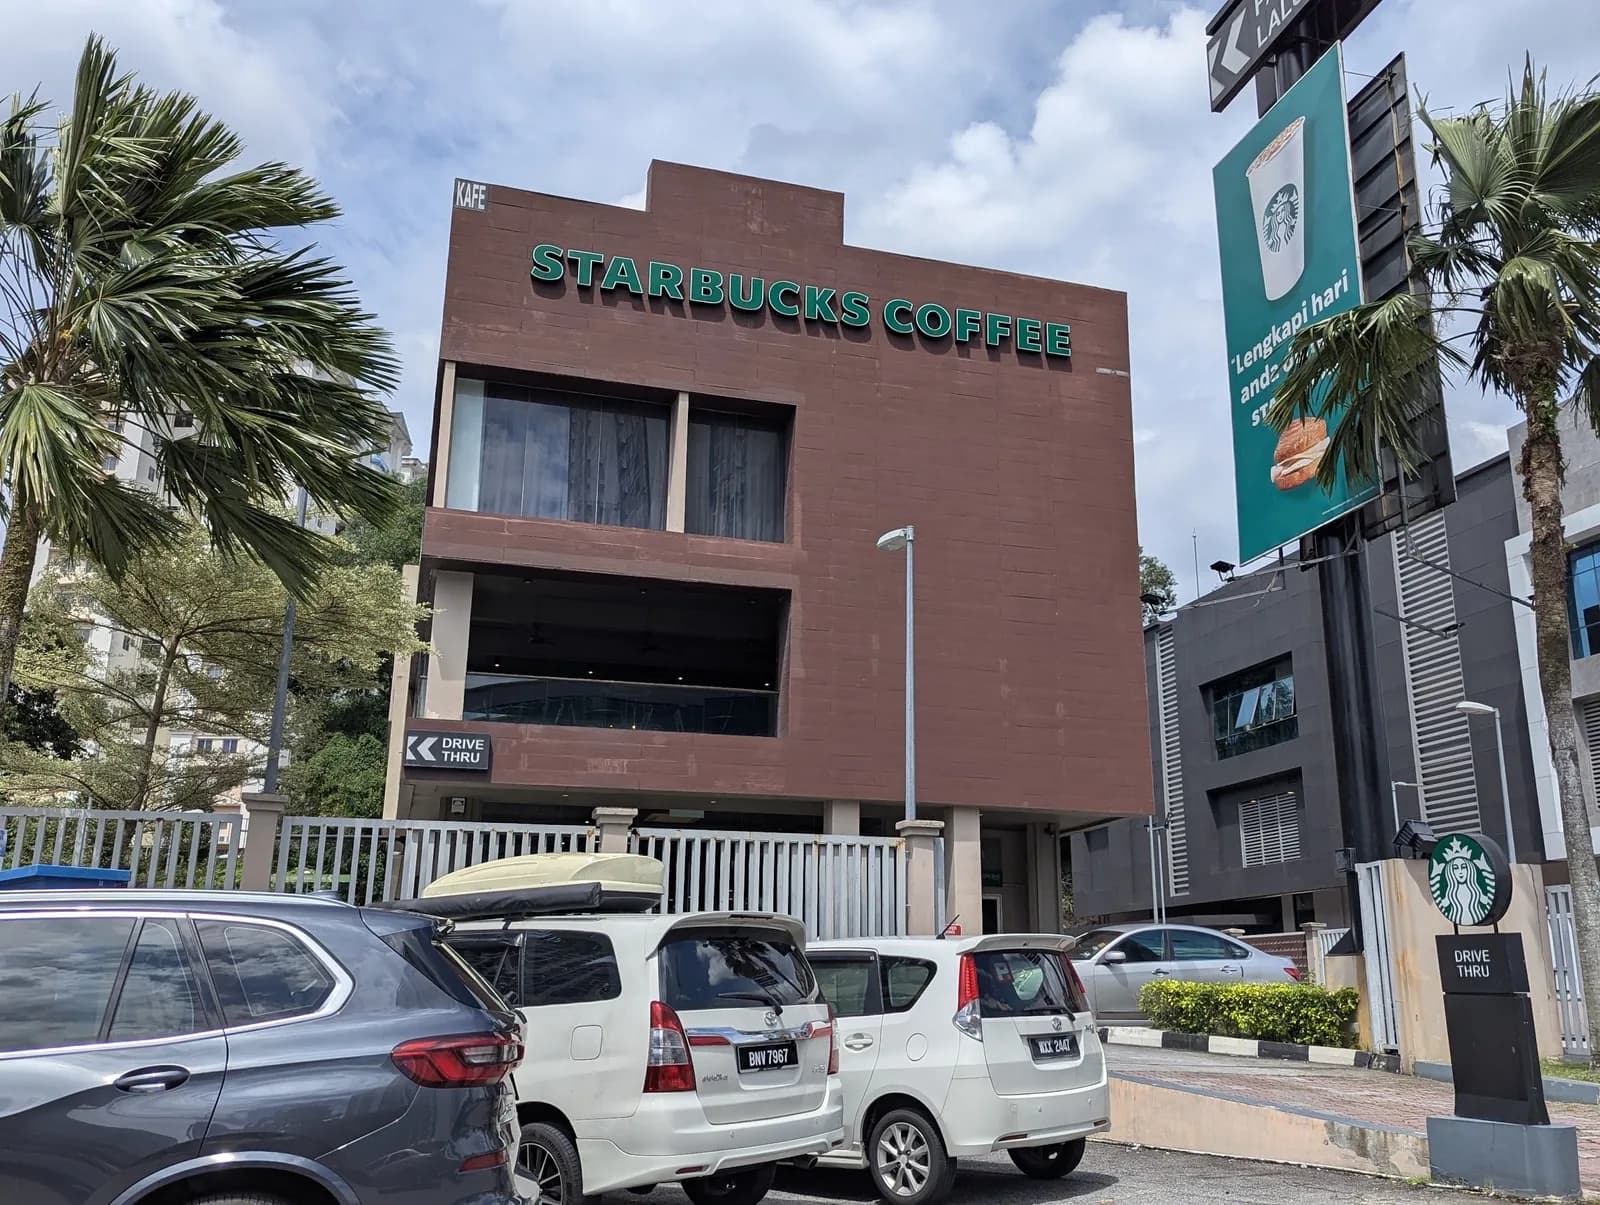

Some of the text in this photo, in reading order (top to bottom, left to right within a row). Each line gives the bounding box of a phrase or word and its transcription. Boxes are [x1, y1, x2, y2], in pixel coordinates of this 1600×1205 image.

[455, 181, 487, 210] KAFE
[1311, 268, 1349, 316] hari
[530, 244, 1072, 357] STARBUCKS COFFEE
[442, 737, 485, 751] DRIVE
[441, 750, 481, 763] THRU
[1454, 949, 1491, 963] DRIVE
[1456, 964, 1490, 978] THRU
[1054, 1038, 1071, 1052] 2447
[749, 1048, 789, 1067] BNV 7967
